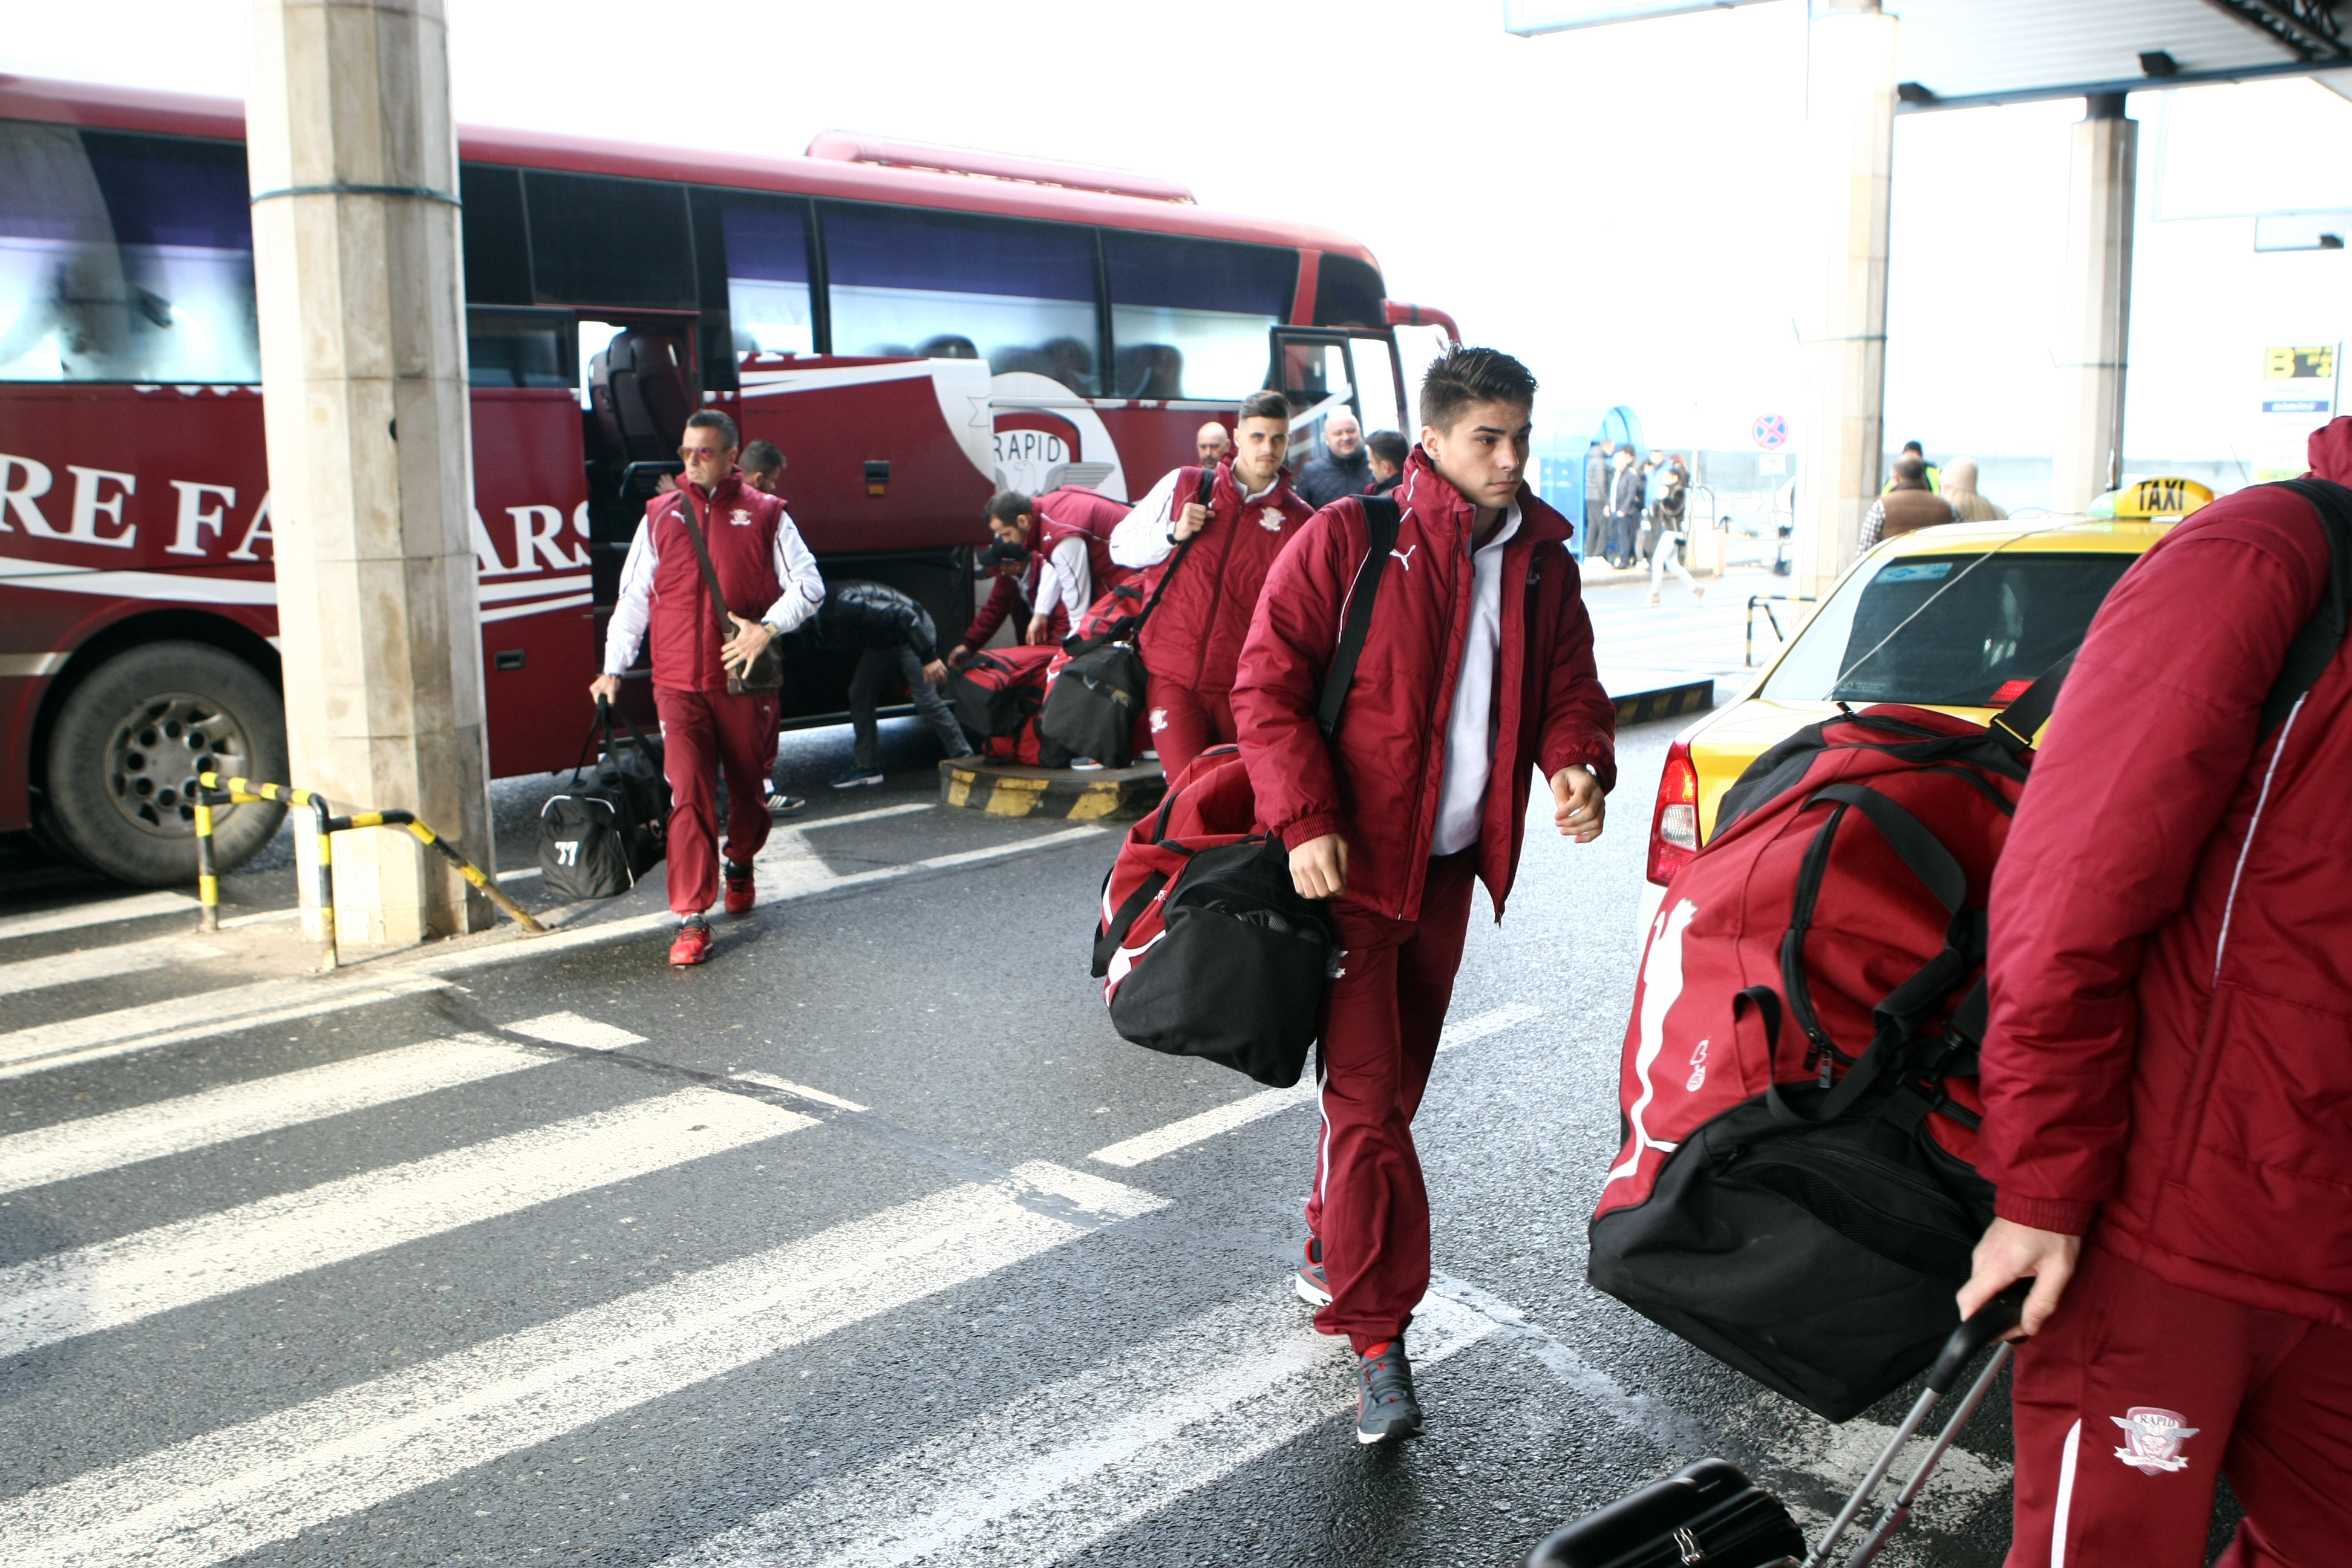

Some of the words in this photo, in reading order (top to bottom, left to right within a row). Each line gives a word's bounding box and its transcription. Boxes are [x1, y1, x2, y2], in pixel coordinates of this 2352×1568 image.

[993, 433, 1061, 462] RAPID
[2137, 480, 2184, 511] TAXI
[554, 841, 578, 866] 77
[2140, 1414, 2175, 1427] RAPID
